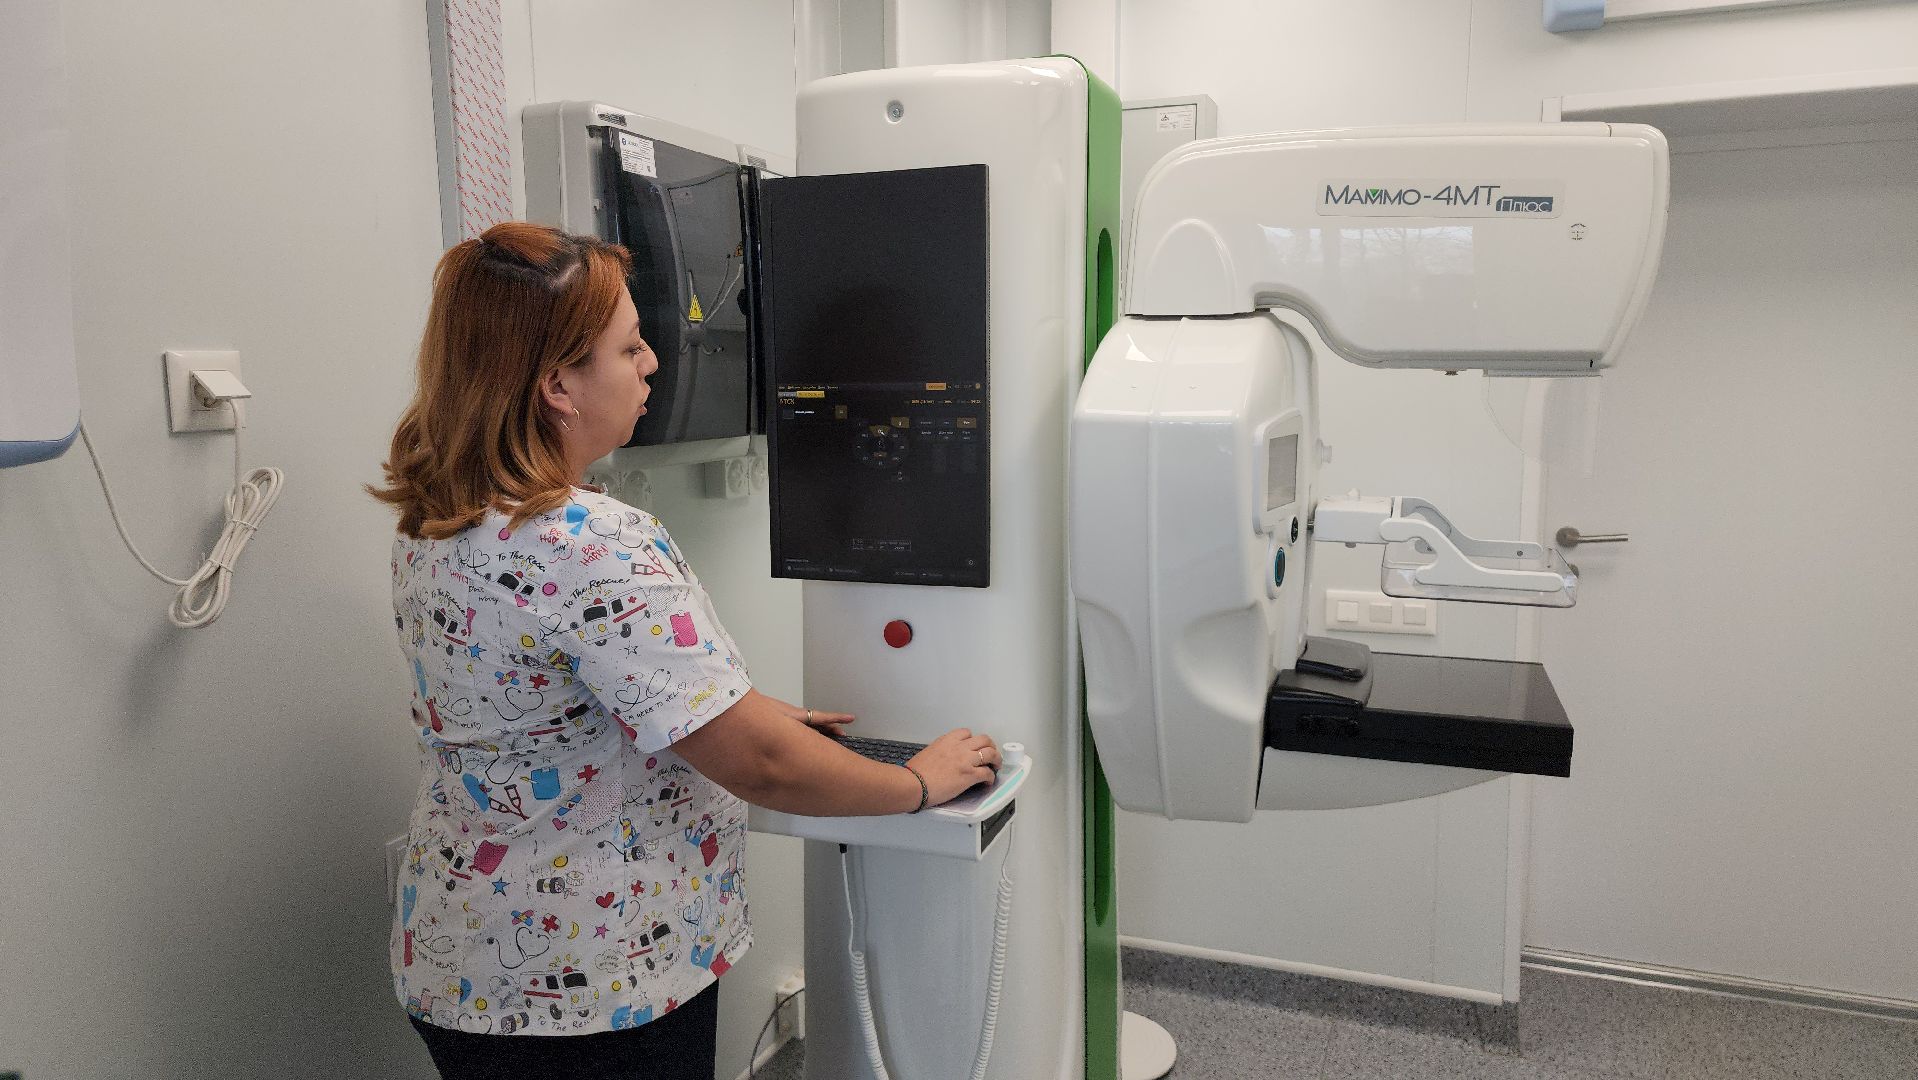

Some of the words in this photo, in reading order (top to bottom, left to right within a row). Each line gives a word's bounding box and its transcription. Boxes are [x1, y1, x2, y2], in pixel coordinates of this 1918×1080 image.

[581, 543, 596, 556] Be
[496, 552, 507, 562] To
[509, 550, 525, 560] The
[563, 600, 574, 609] To
[572, 587, 586, 600] The
[551, 1021, 567, 1032] The
